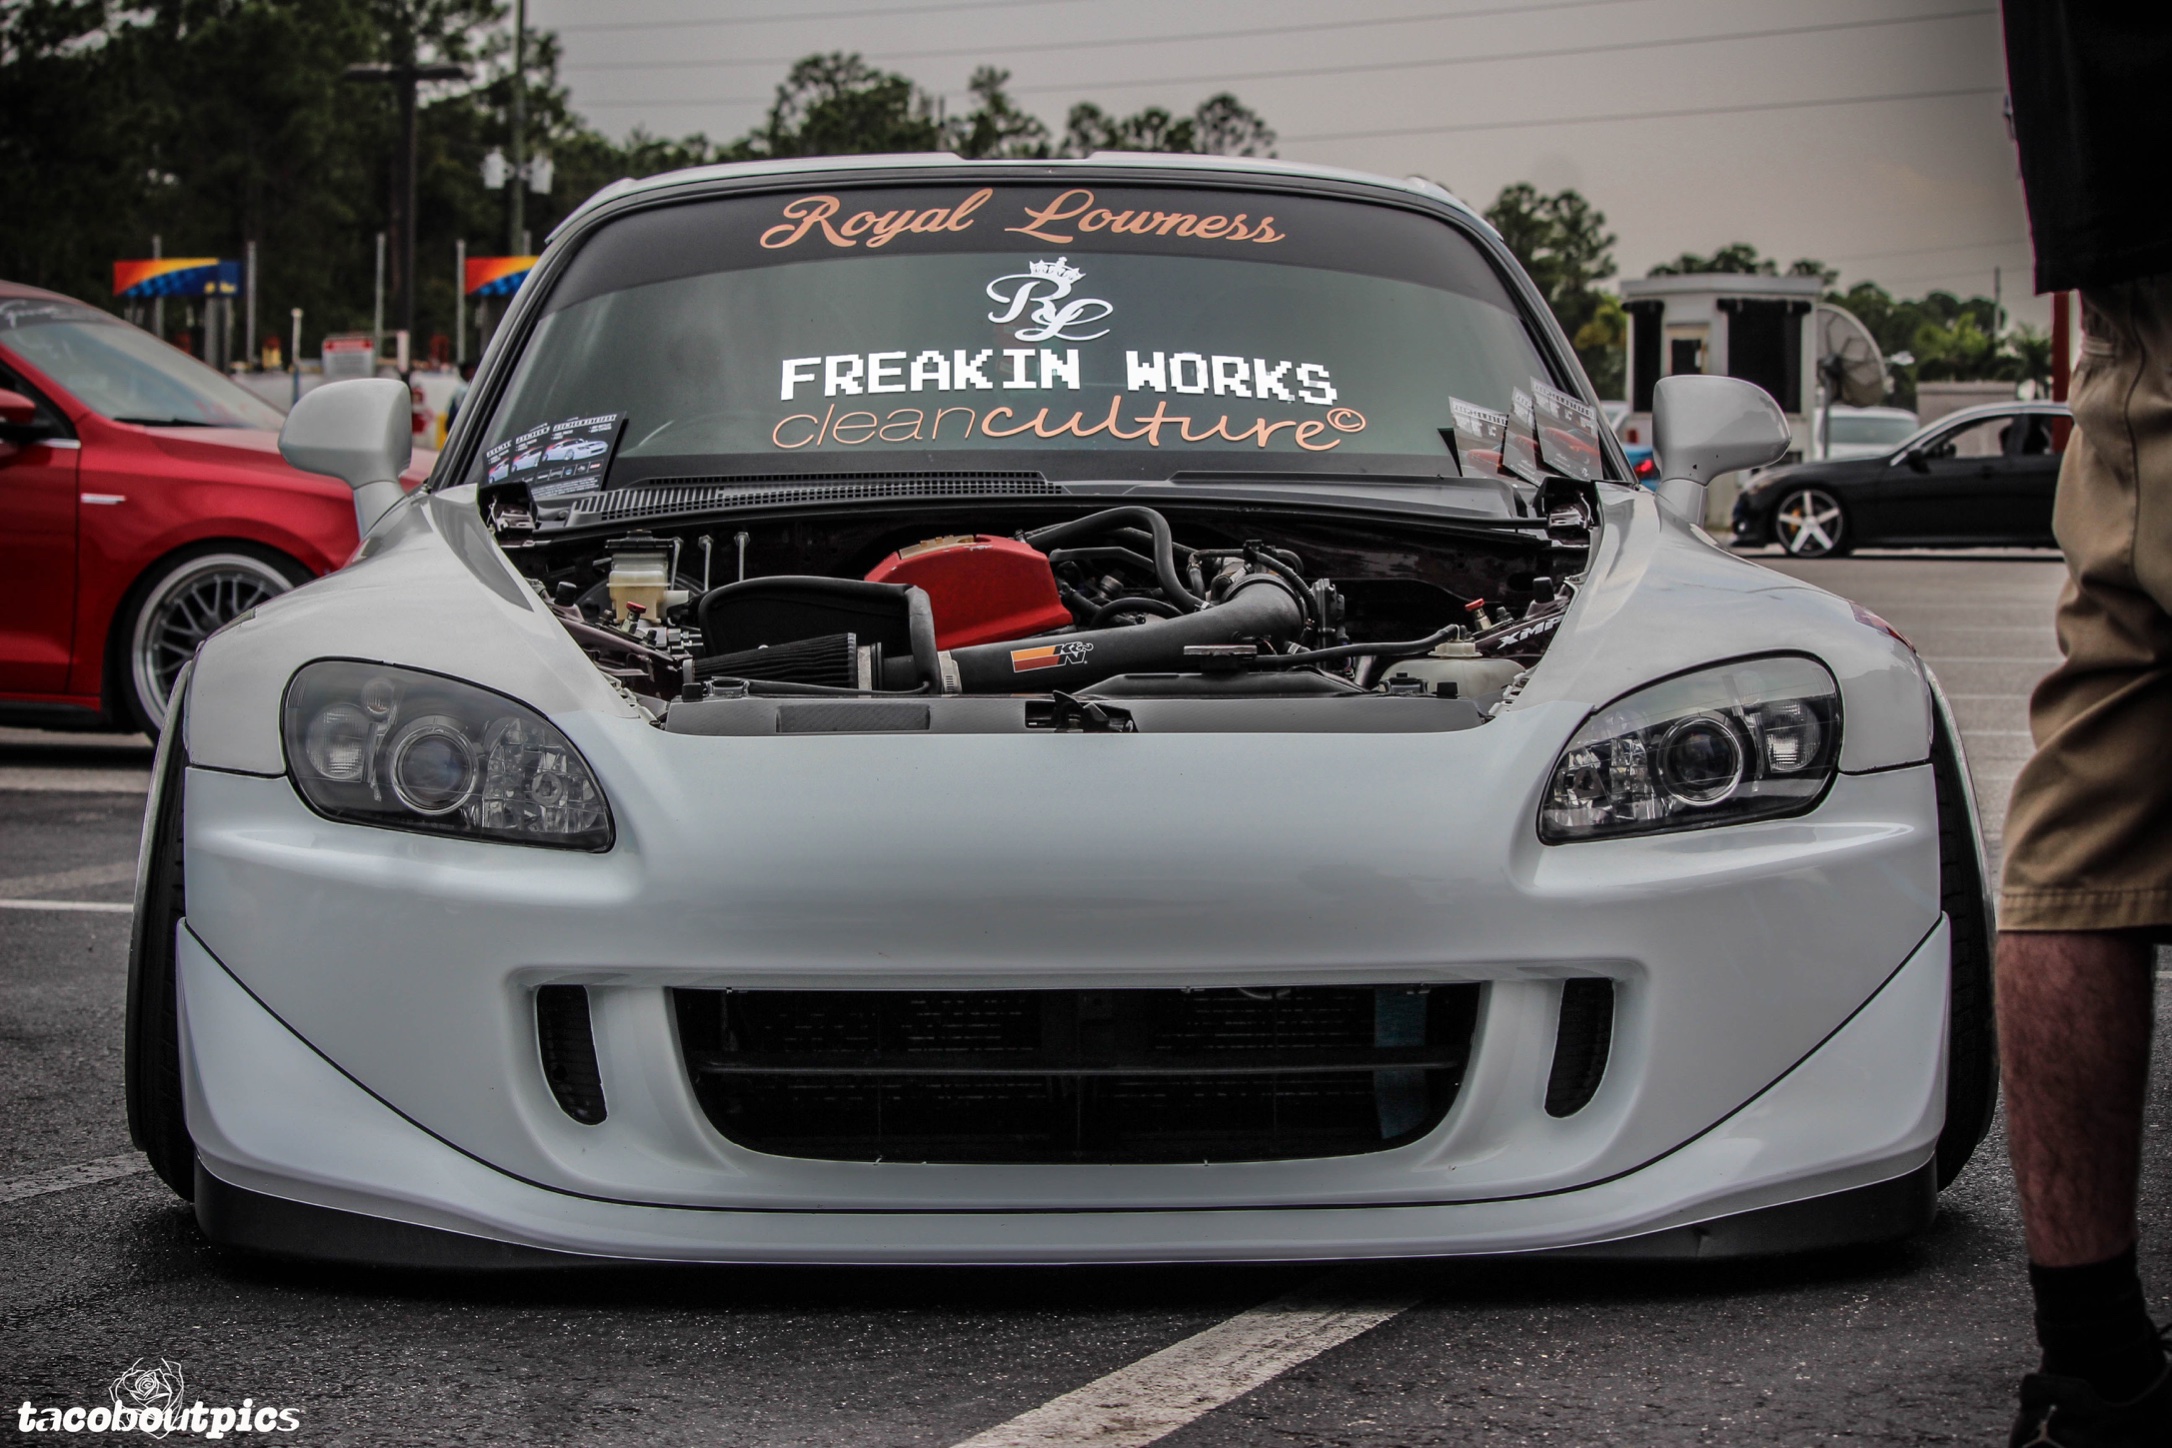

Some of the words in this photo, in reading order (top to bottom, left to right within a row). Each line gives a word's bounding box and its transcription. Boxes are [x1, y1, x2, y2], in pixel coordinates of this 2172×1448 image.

[759, 188, 994, 250] Royal
[1004, 188, 1286, 245] Lowness
[780, 349, 1081, 401] FREAKIN
[1125, 350, 1338, 406] WORKS
